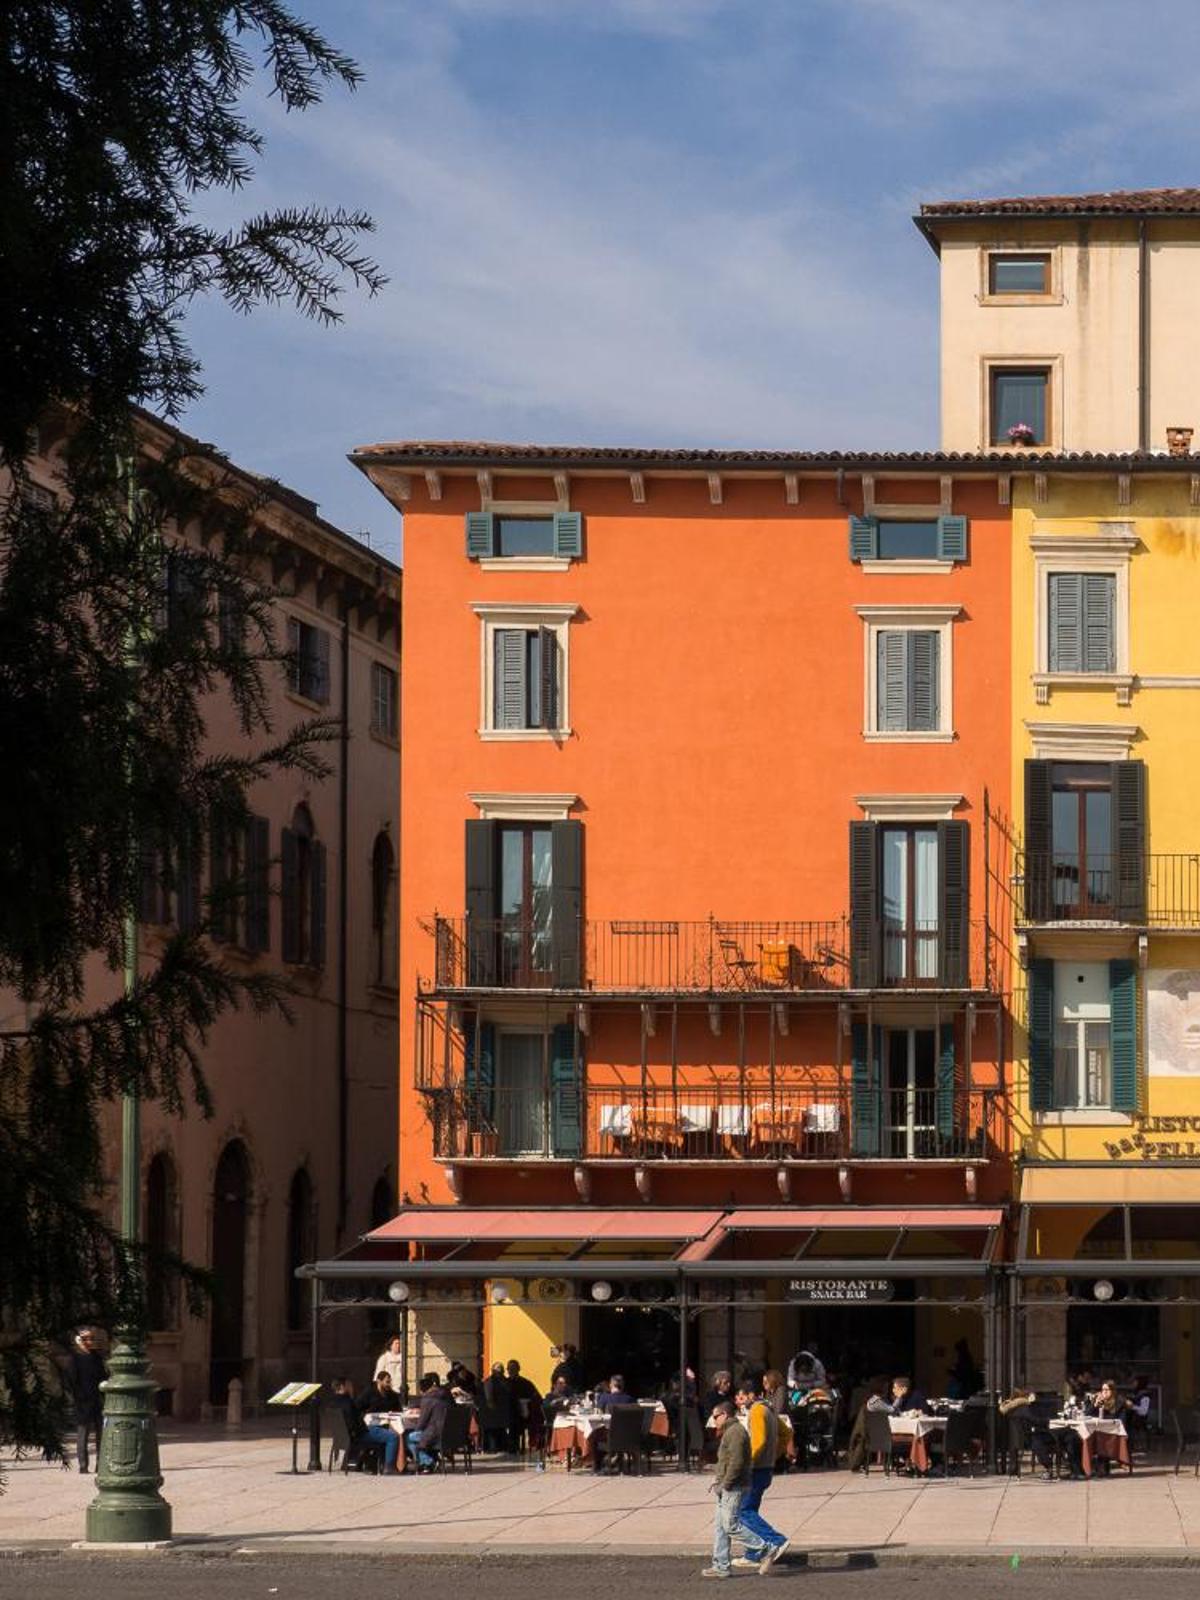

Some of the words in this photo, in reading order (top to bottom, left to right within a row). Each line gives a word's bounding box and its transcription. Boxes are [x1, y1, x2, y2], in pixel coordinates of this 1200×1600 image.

[790, 1280, 888, 1290] RISTORANTE
[810, 1290, 844, 1299] SNACK
[846, 1290, 868, 1299] BAR
